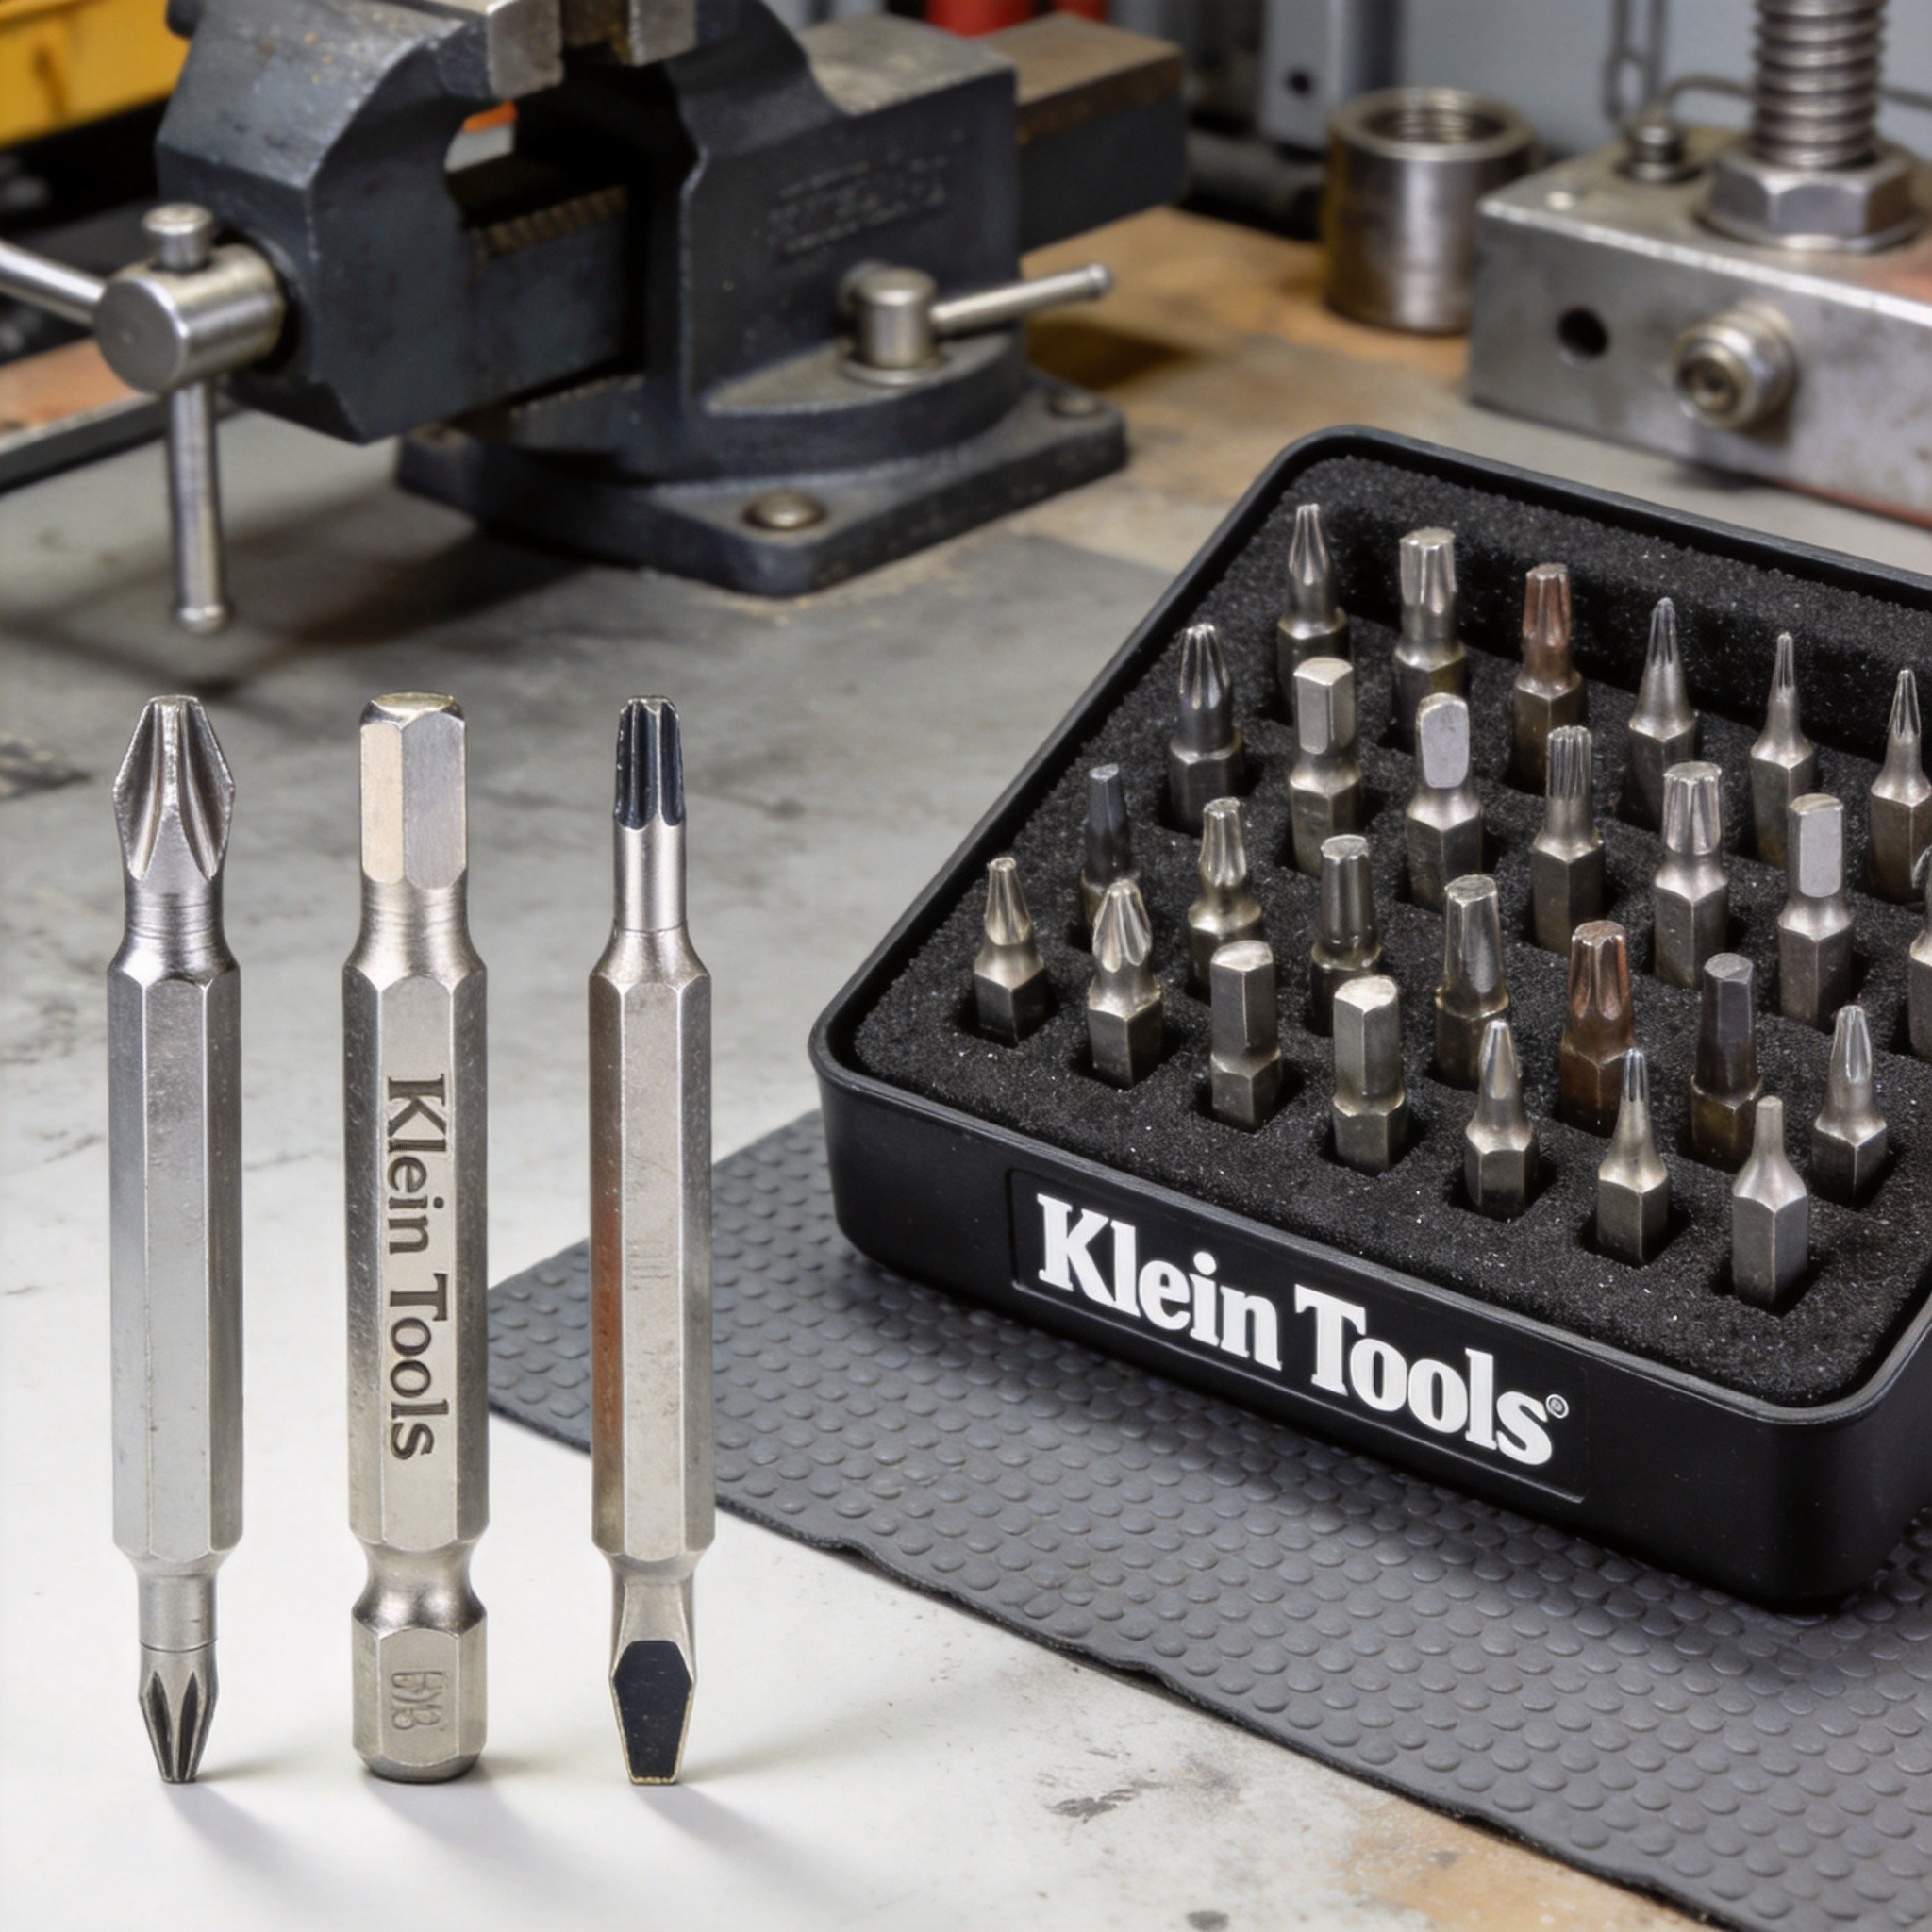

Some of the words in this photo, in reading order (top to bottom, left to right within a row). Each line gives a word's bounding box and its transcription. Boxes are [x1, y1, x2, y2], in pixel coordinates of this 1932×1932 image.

[386, 1073, 448, 1256] Klein
[389, 1272, 450, 1461] Tools
[1036, 1193, 1282, 1371] Klein
